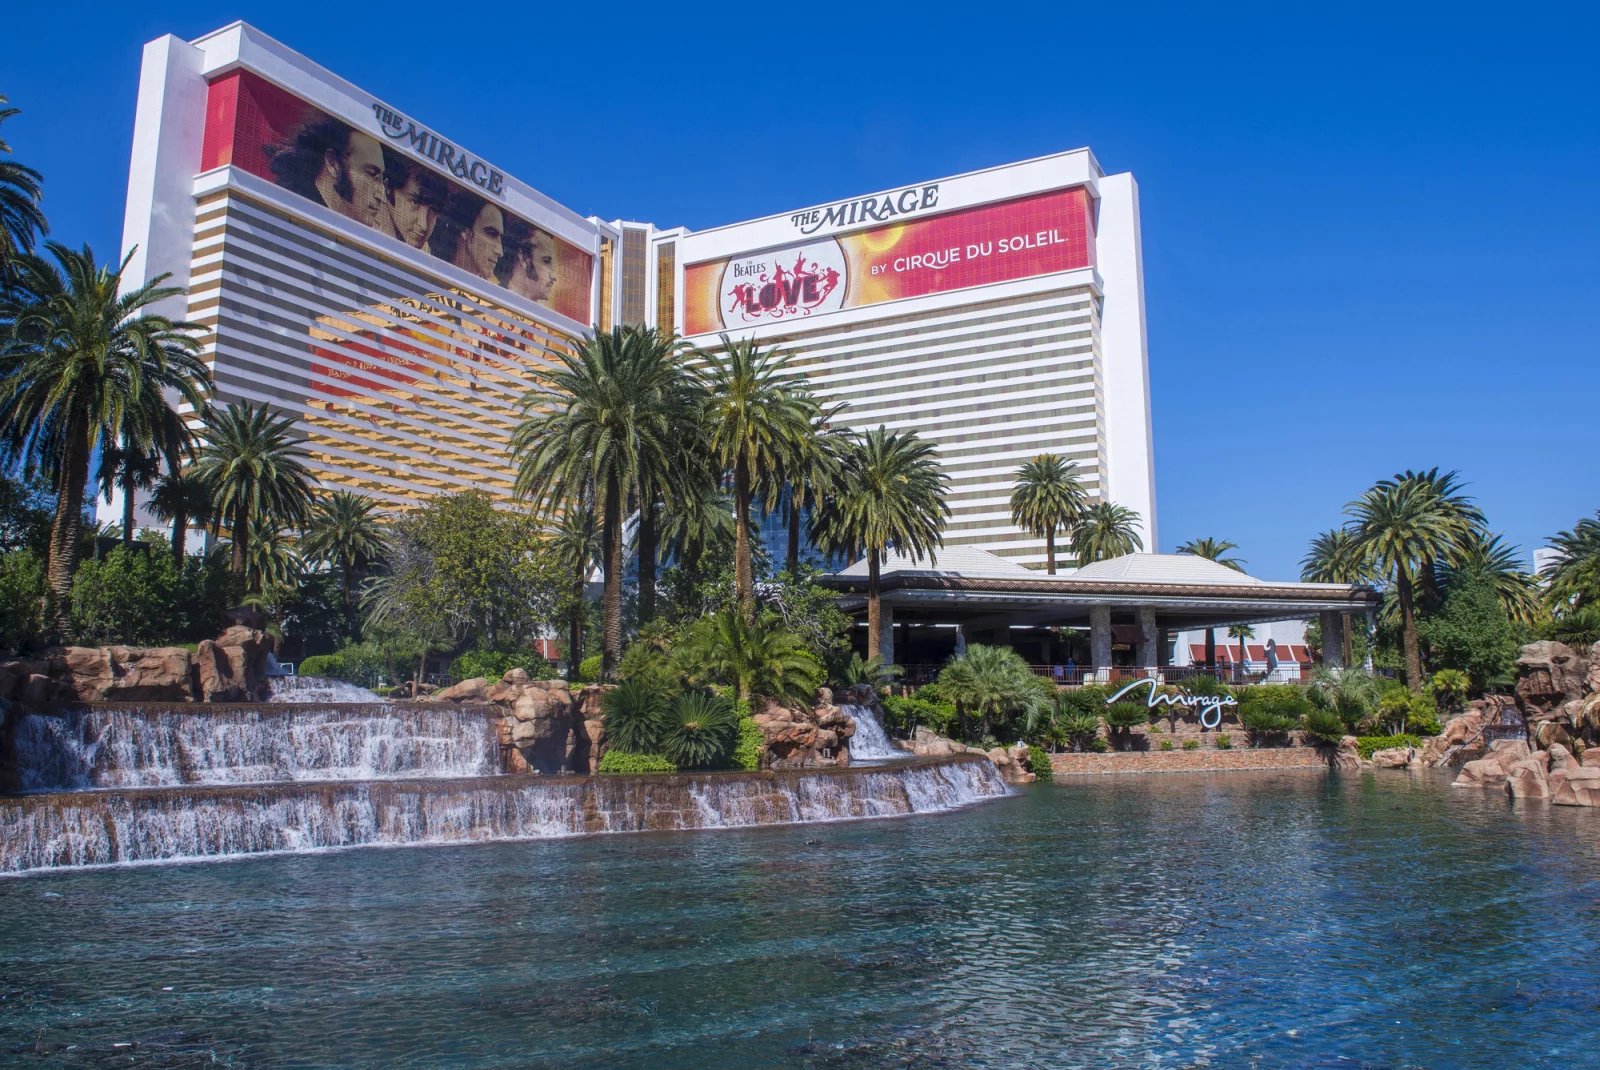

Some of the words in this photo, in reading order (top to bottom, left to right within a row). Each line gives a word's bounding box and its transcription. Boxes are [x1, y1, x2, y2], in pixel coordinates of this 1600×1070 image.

[373, 104, 403, 131] THE
[382, 122, 504, 197] MIRAGE
[791, 210, 820, 227] THE
[801, 184, 939, 235] MIRAGE
[734, 262, 766, 278] BEATLES
[871, 263, 887, 275] BY
[893, 248, 960, 270] CIRQUE
[966, 241, 993, 260] DU
[998, 229, 1065, 253] SOLEIL
[745, 274, 820, 314] LOVE
